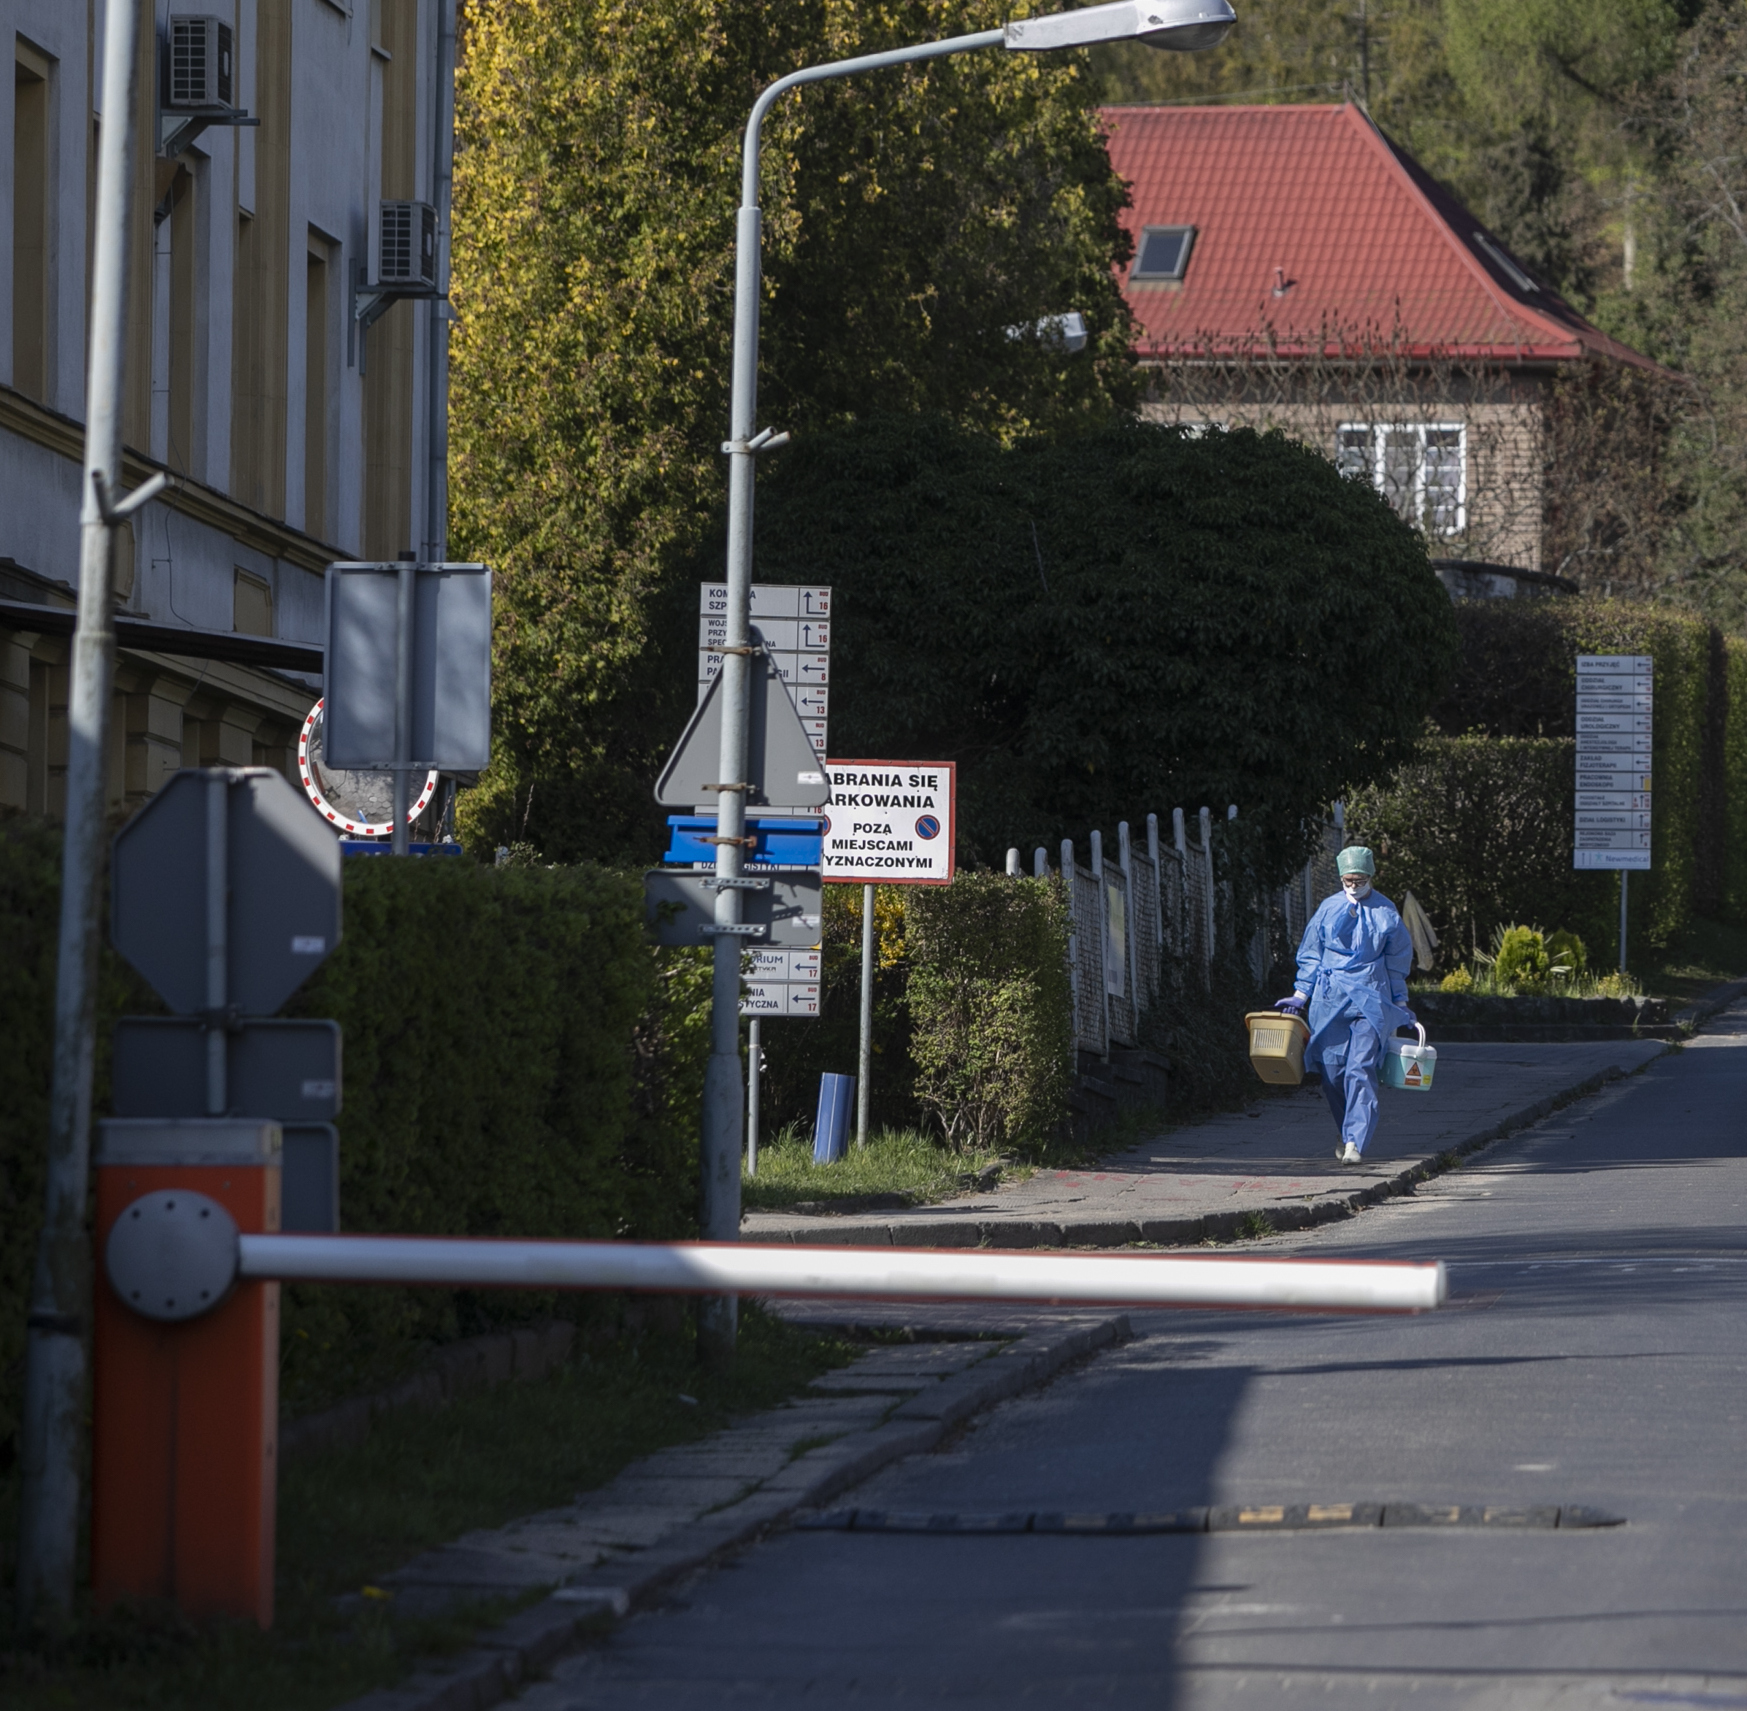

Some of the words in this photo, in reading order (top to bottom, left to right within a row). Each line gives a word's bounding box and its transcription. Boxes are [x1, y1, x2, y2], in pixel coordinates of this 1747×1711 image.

[819, 602, 828, 610] 16
[818, 635, 827, 643] 16
[816, 706, 825, 714] 13
[815, 739, 824, 747] 13
[824, 772, 903, 787] ABRANIA
[909, 774, 938, 791] SIĘ
[824, 793, 935, 808] ARKOWANIA
[853, 823, 892, 834] POZA
[832, 839, 913, 851] MIEJSCAMI
[823, 855, 932, 868] YZNACZONYMI
[808, 969, 818, 977] 17
[808, 1003, 817, 1011] 17
